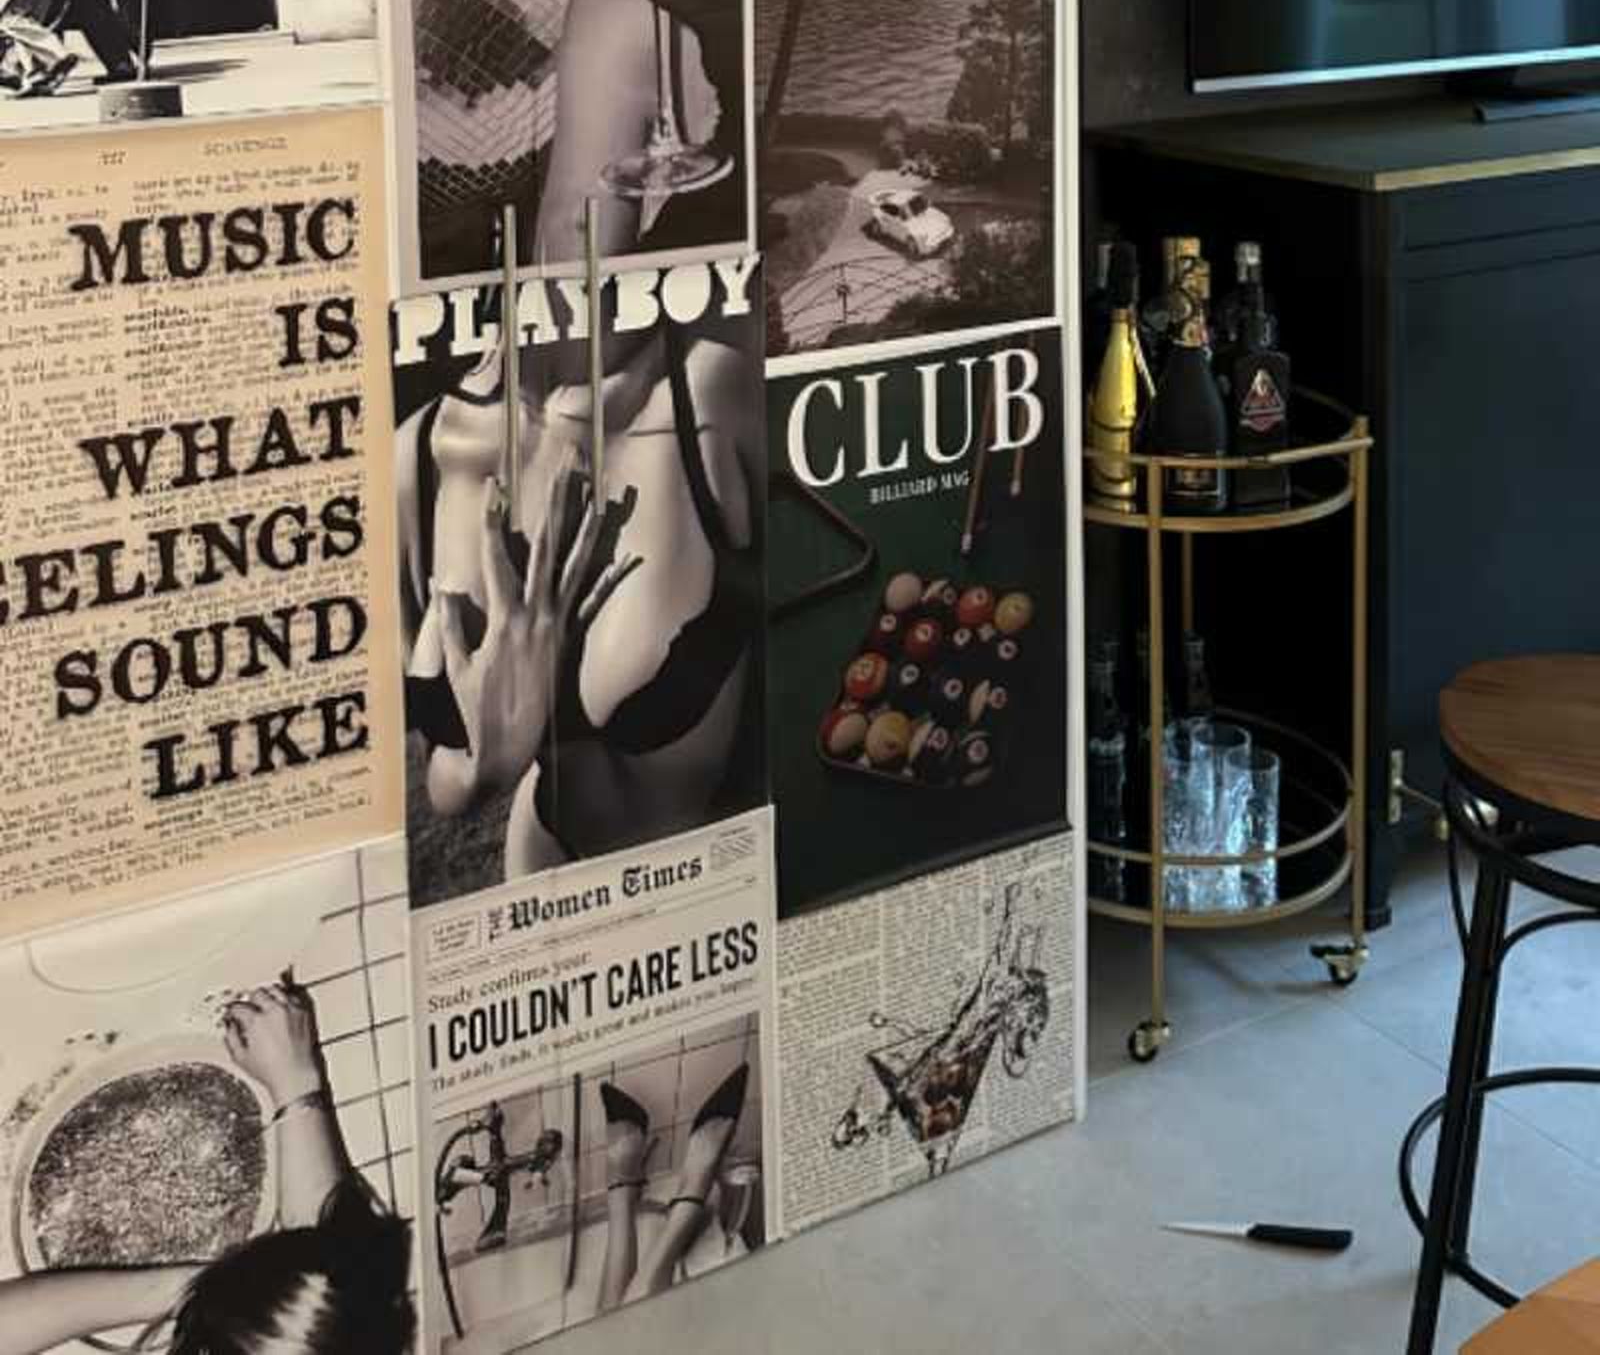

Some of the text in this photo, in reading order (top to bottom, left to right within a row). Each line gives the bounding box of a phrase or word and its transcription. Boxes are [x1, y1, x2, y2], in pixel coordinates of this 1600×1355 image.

[70, 198, 356, 291] MUSIC
[277, 297, 358, 368] IS
[391, 251, 761, 366] PLAYBOY
[79, 397, 361, 498] WHAT
[787, 348, 1044, 487] CLUB
[55, 597, 368, 720] SOUND
[145, 692, 370, 800] LIKE
[508, 884, 611, 931] Women
[621, 857, 703, 898] Times
[428, 1023, 438, 1070] I
[449, 972, 598, 1062] COULDN'T
[607, 945, 682, 1010] CARE
[690, 921, 758, 983] LESS
[428, 985, 473, 1014] Study
